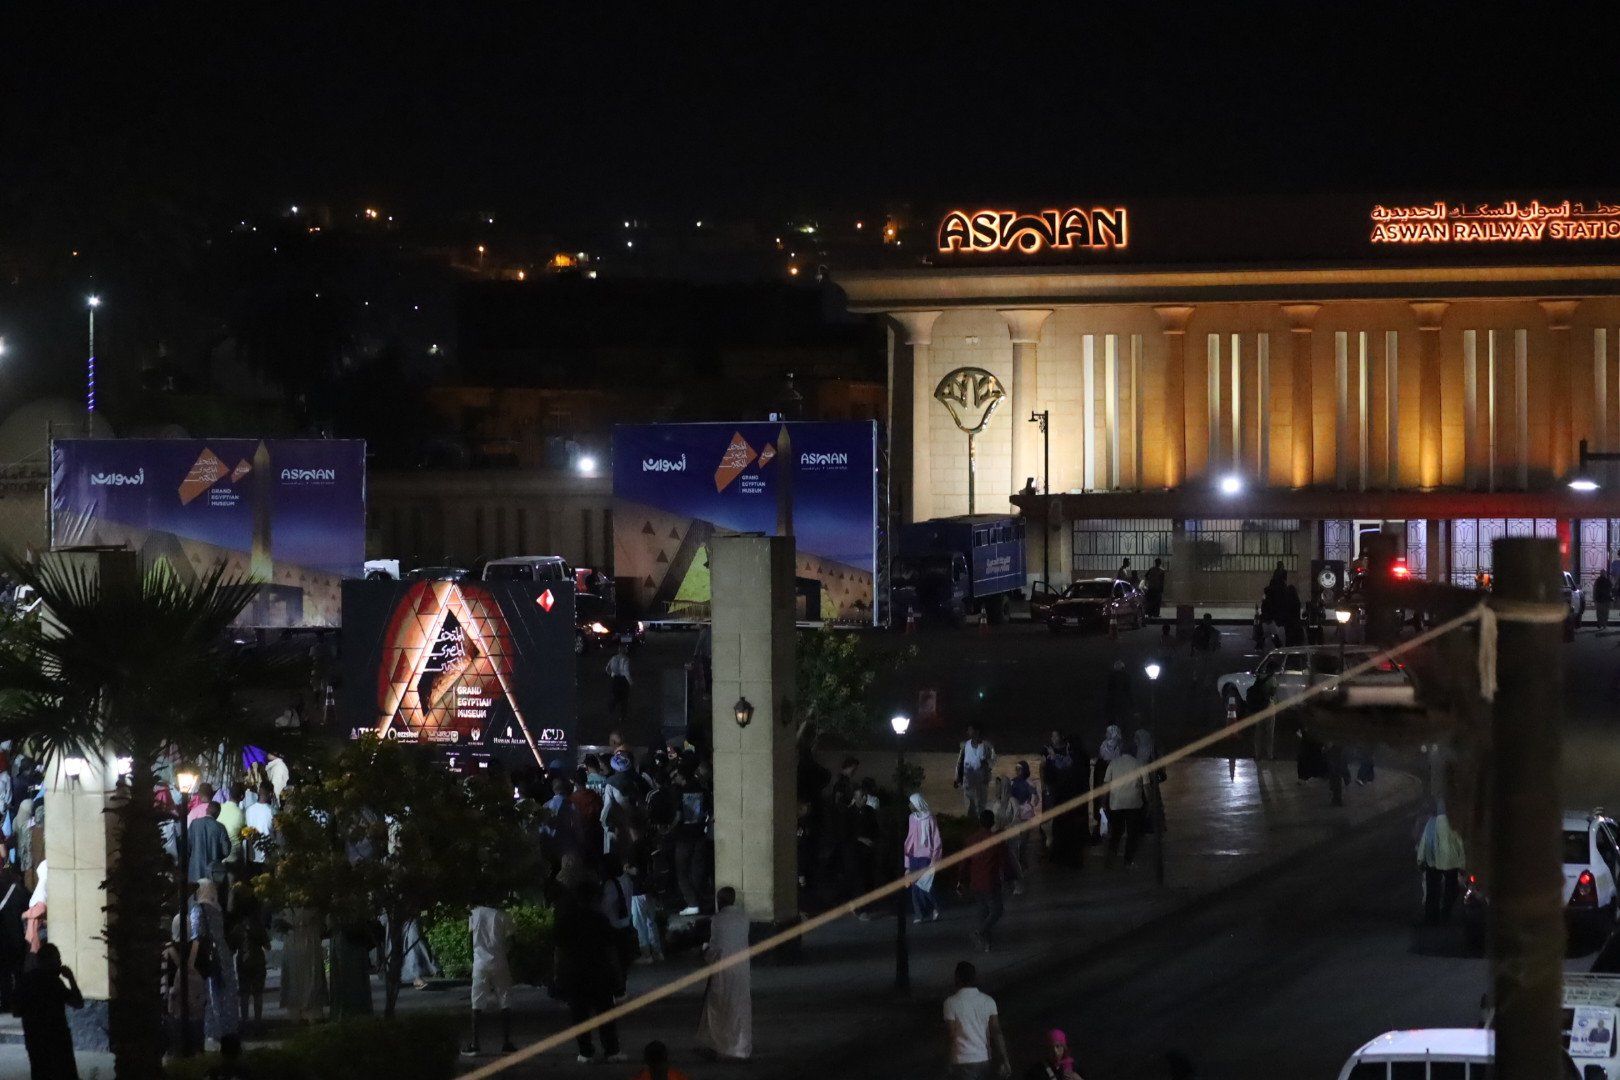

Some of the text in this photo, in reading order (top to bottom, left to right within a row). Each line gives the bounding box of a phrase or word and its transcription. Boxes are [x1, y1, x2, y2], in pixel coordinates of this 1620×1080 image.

[1371, 200, 1620, 222] حطة أسوان للسكك الحديدية
[938, 208, 1127, 253] ASWAN
[1371, 220, 1620, 242] ASWAN RAILWAY STATIO
[642, 452, 687, 472] أسوان
[800, 452, 848, 465] ASWAN
[91, 467, 145, 486] أسوان
[281, 468, 336, 481] ASWAN
[457, 686, 482, 695] GRAND
[457, 698, 492, 707] EGYPTIAN
[457, 709, 487, 718] MUSEUM
